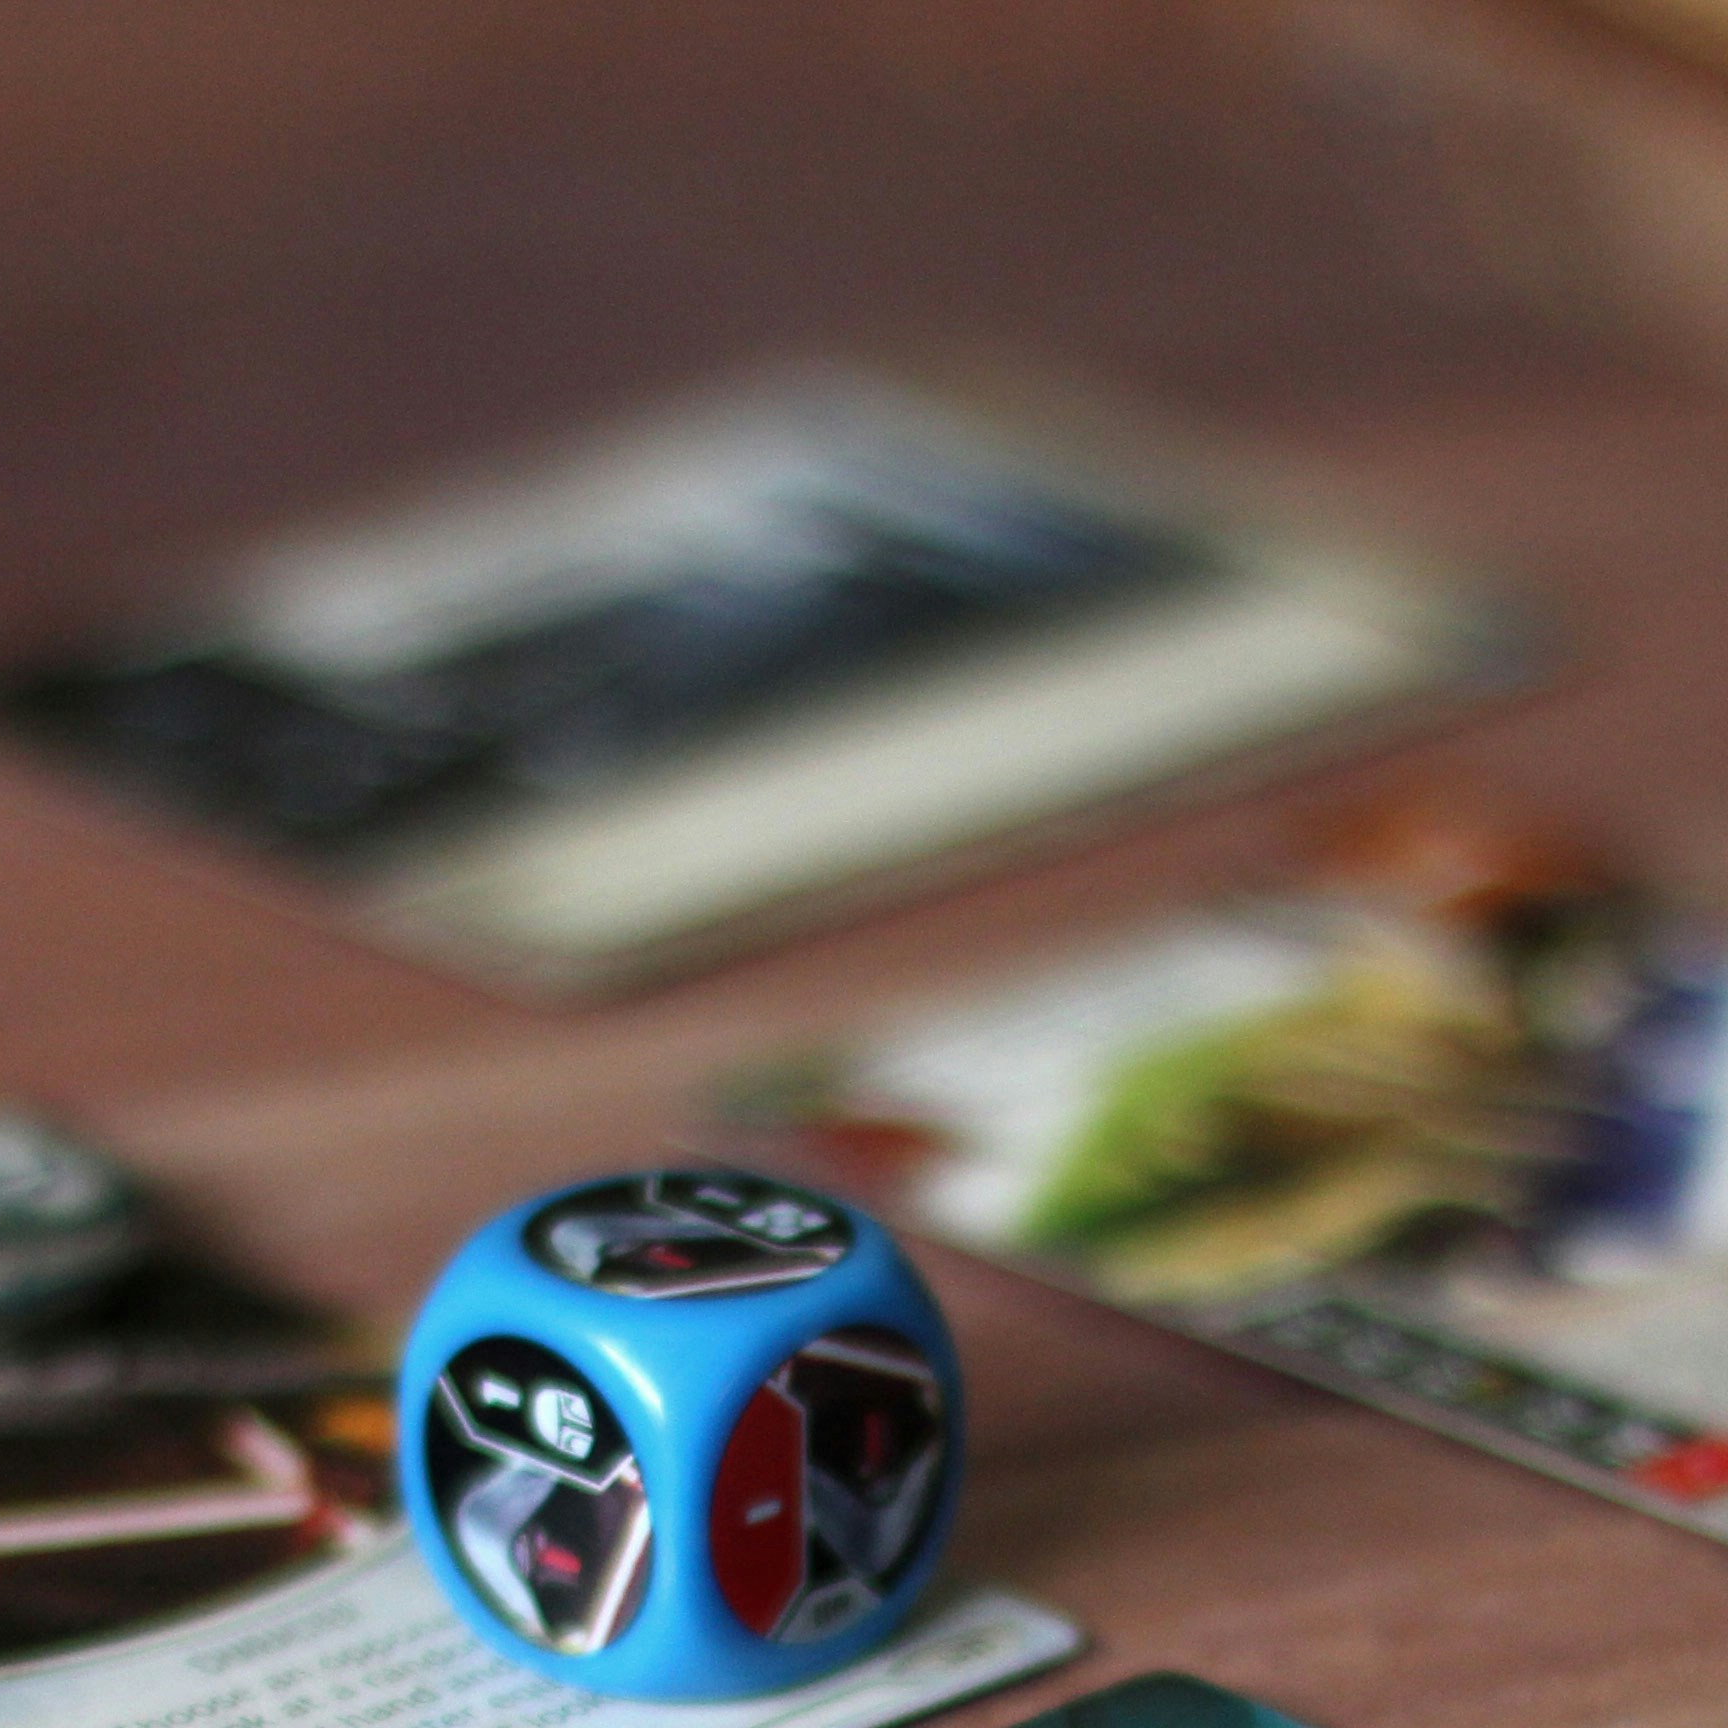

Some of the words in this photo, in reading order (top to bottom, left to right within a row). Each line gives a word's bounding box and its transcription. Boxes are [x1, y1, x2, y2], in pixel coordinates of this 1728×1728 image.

[265, 1666, 313, 1691] an
[281, 1692, 320, 1720] at
[360, 1640, 483, 1688] rando
